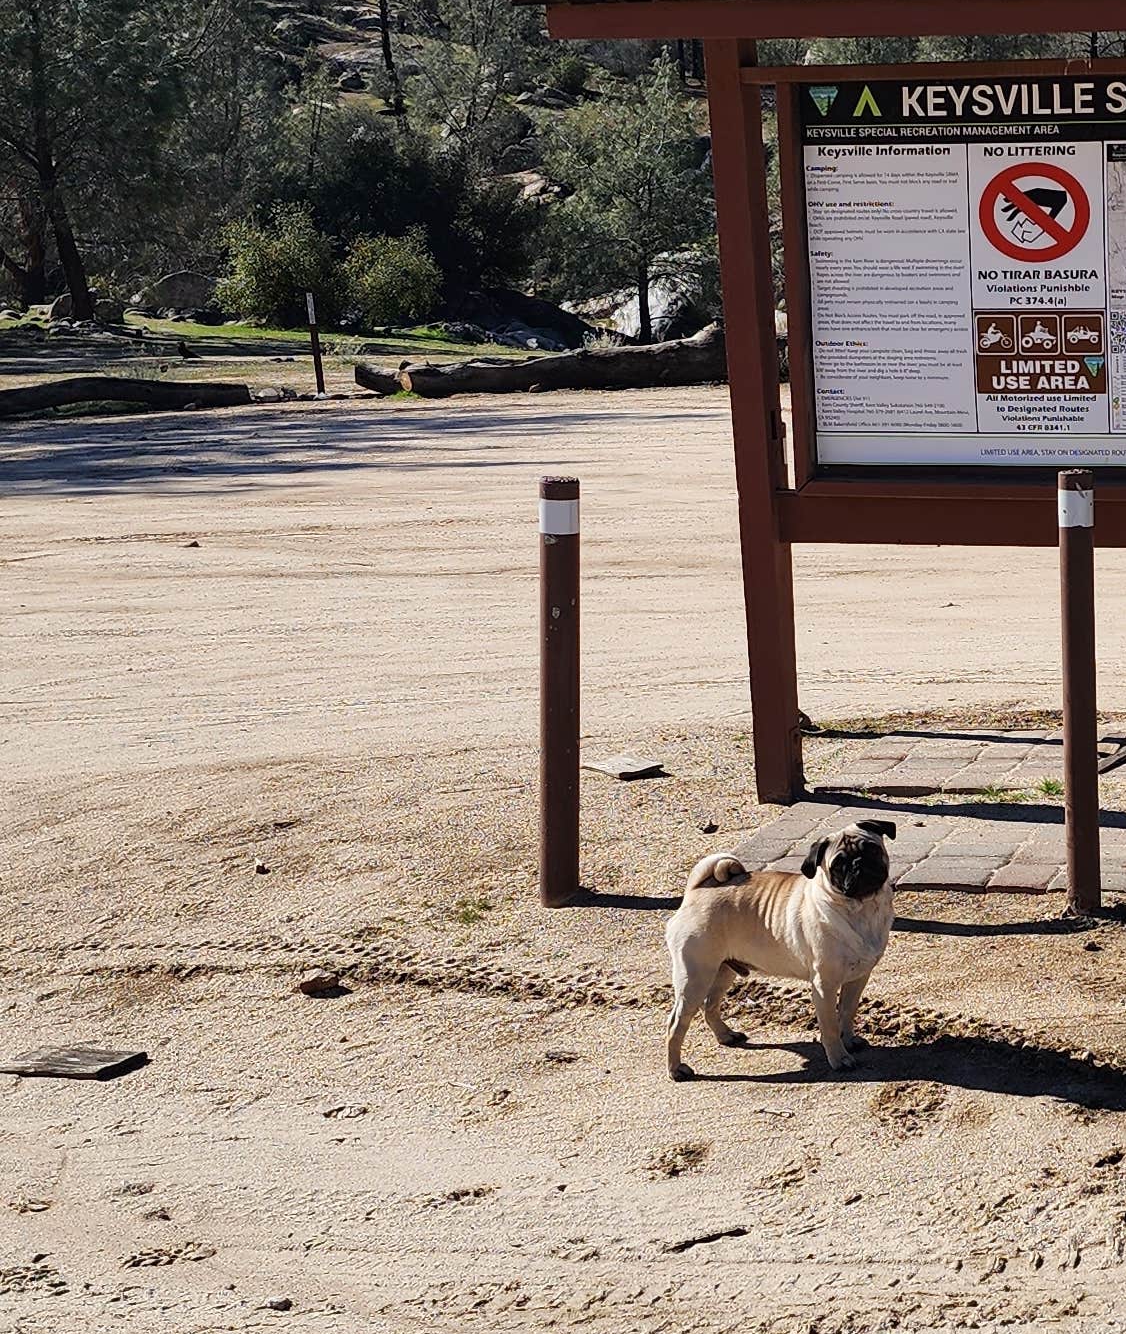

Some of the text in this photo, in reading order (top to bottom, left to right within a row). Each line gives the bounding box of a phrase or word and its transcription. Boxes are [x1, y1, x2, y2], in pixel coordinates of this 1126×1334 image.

[902, 82, 1095, 117] KEYSVILLE
[806, 125, 1060, 138] KEYSVILLE SPECIAL RECREATION MANAGEMENT AREA
[817, 145, 951, 159] Keysville Information
[983, 145, 1076, 157] NO LITTERING
[978, 270, 1098, 280] NO TIRAR BASURA
[986, 284, 1038, 292] Violations
[1010, 296, 1067, 306] PC 374.4(a)
[1000, 360, 1080, 374] LIMITED
[992, 376, 1090, 389] USE AREA
[1008, 406, 1056, 414] Designated
